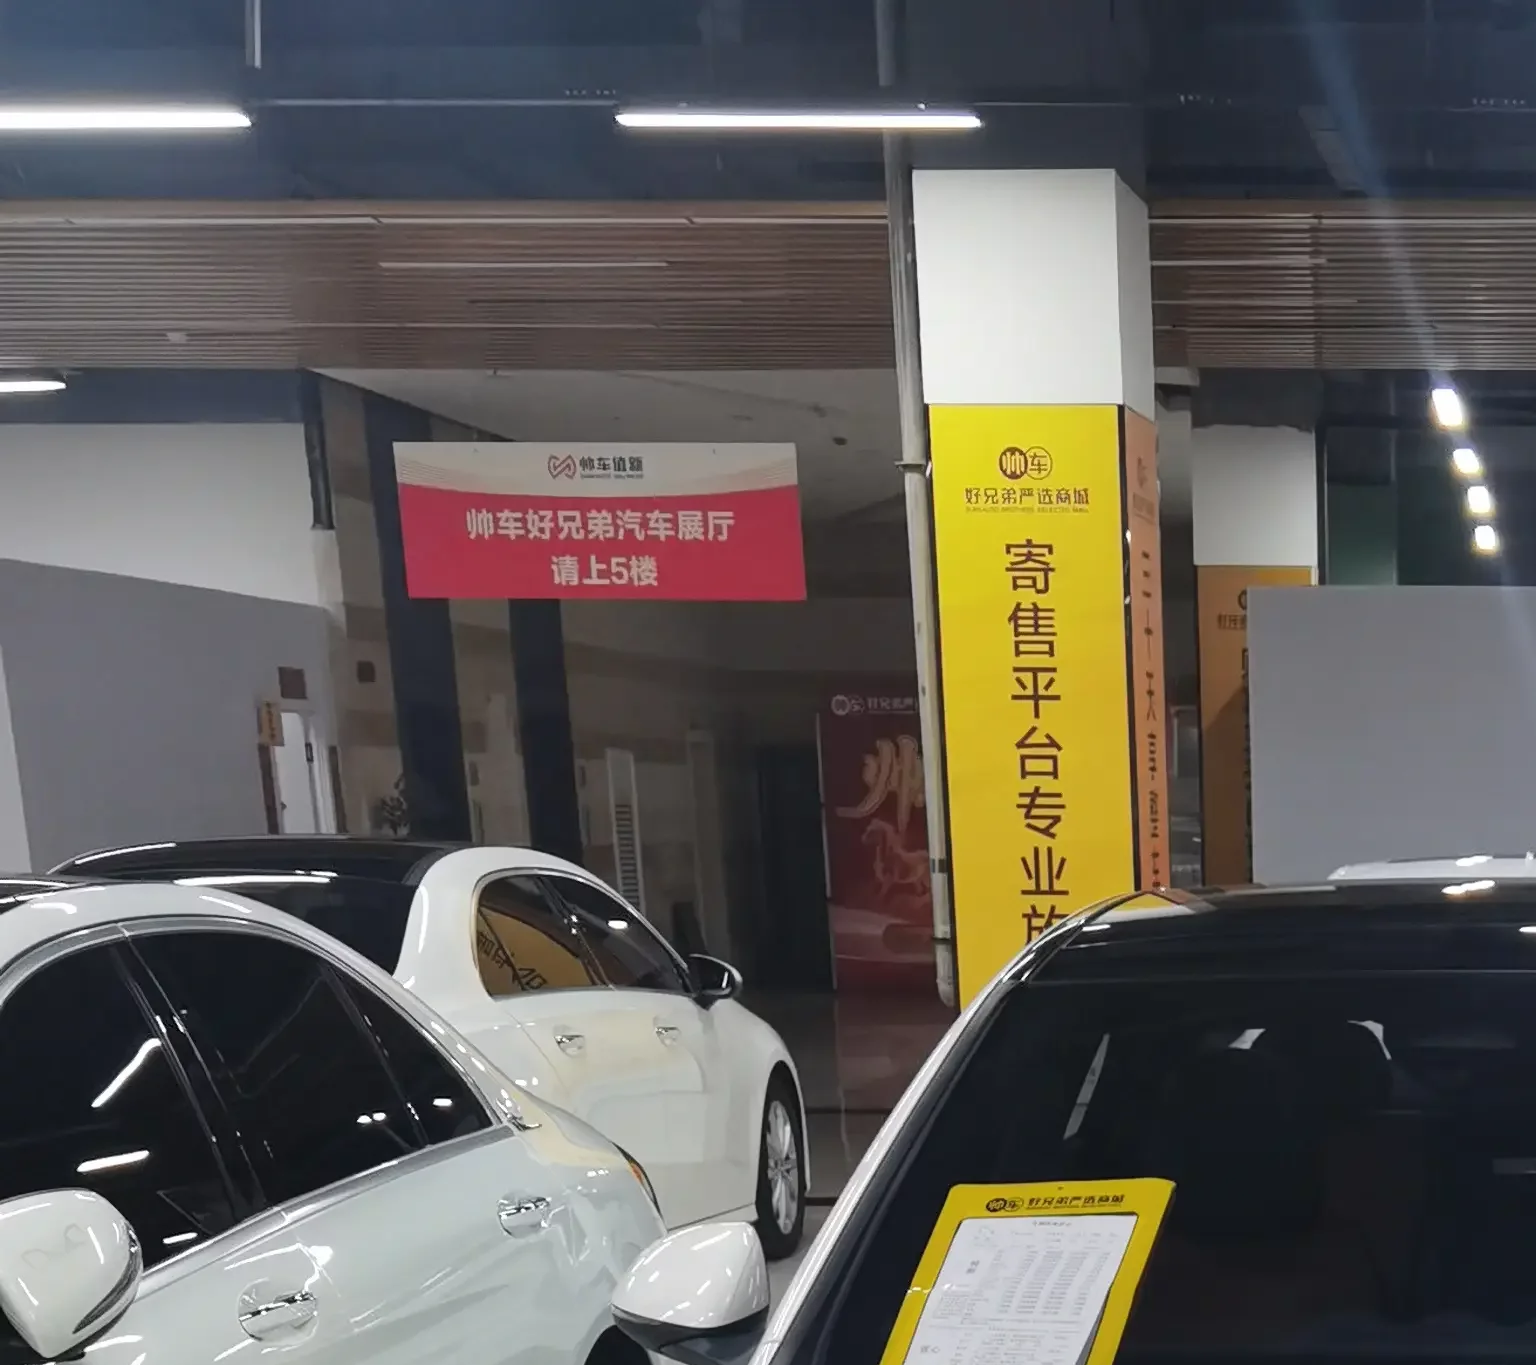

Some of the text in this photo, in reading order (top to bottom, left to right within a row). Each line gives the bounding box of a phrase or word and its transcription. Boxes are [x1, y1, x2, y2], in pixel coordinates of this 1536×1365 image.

[965, 487, 1089, 505] 好兄弟严选商城
[466, 509, 735, 541] 帅车好兄弟汽车展厅
[551, 555, 659, 586] 请上5楼
